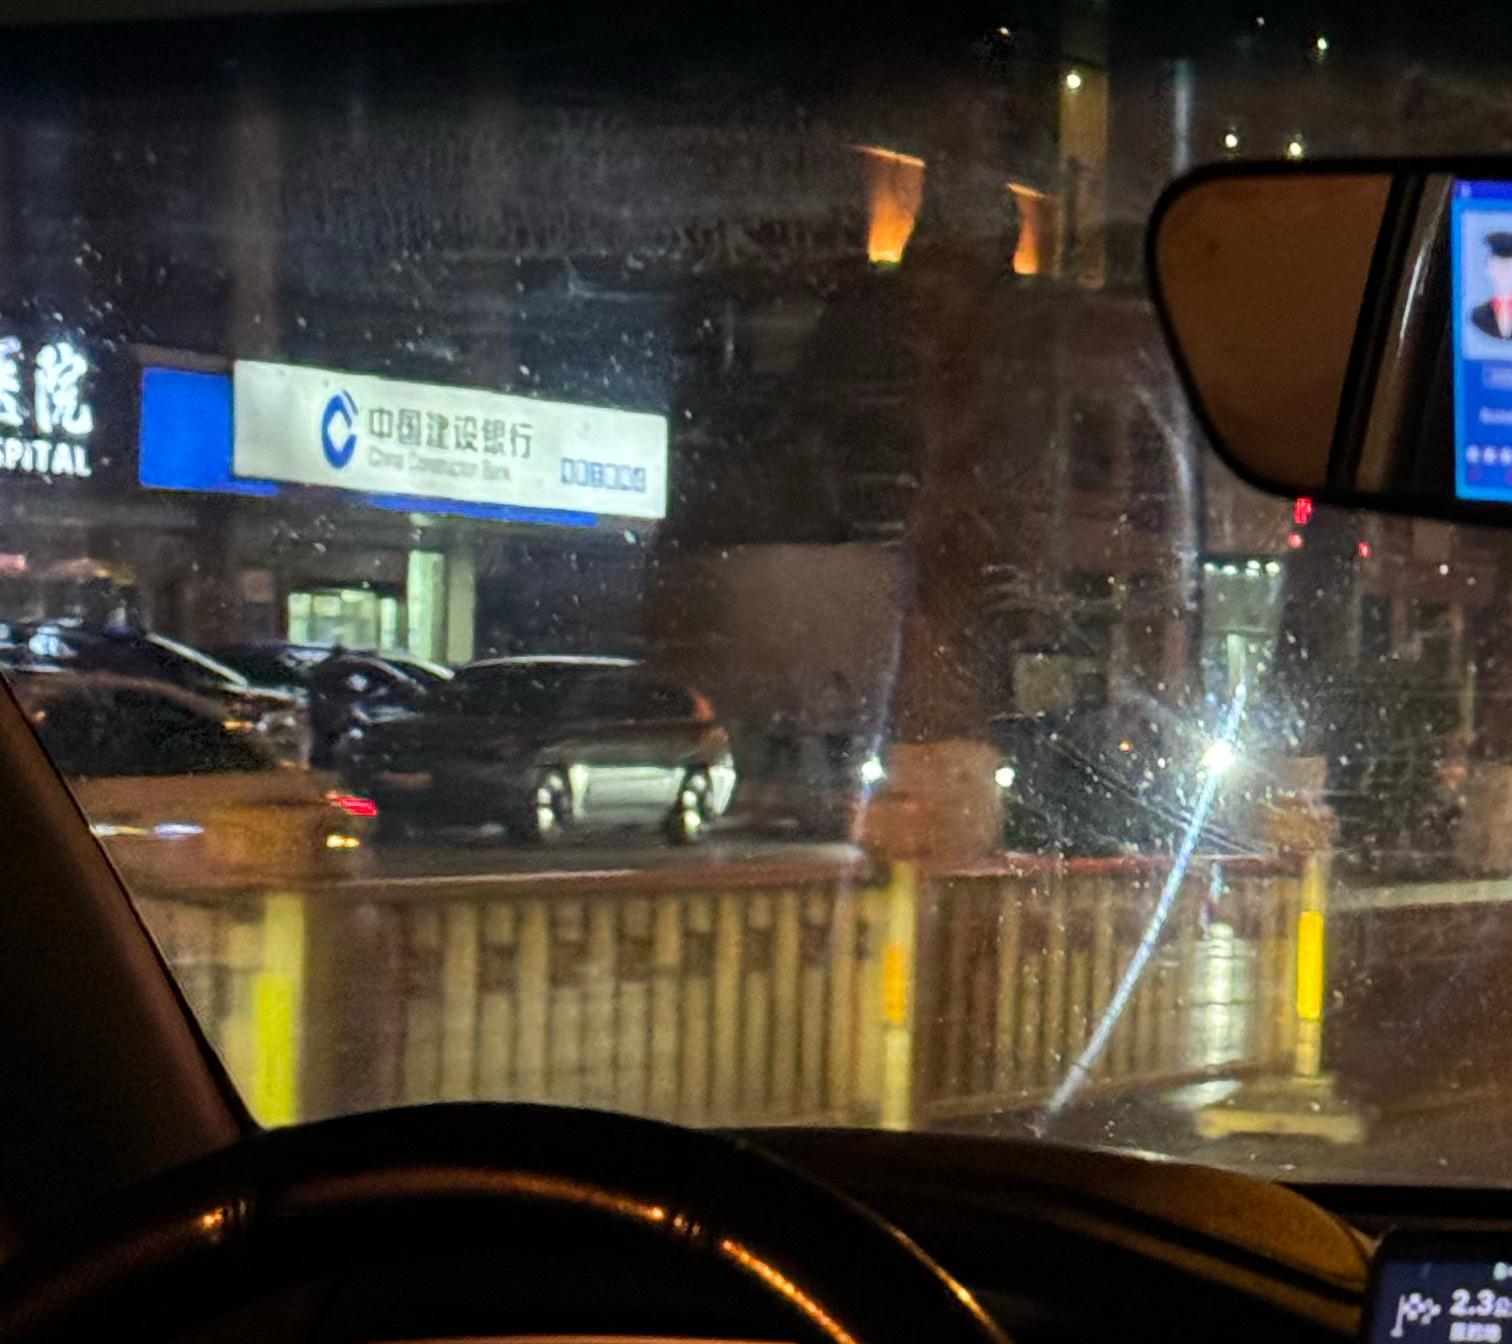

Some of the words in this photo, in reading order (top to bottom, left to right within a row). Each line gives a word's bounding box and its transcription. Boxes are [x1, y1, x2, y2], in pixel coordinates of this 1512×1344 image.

[368, 407, 532, 459] 中国建设银行
[0, 436, 93, 478] PITAL
